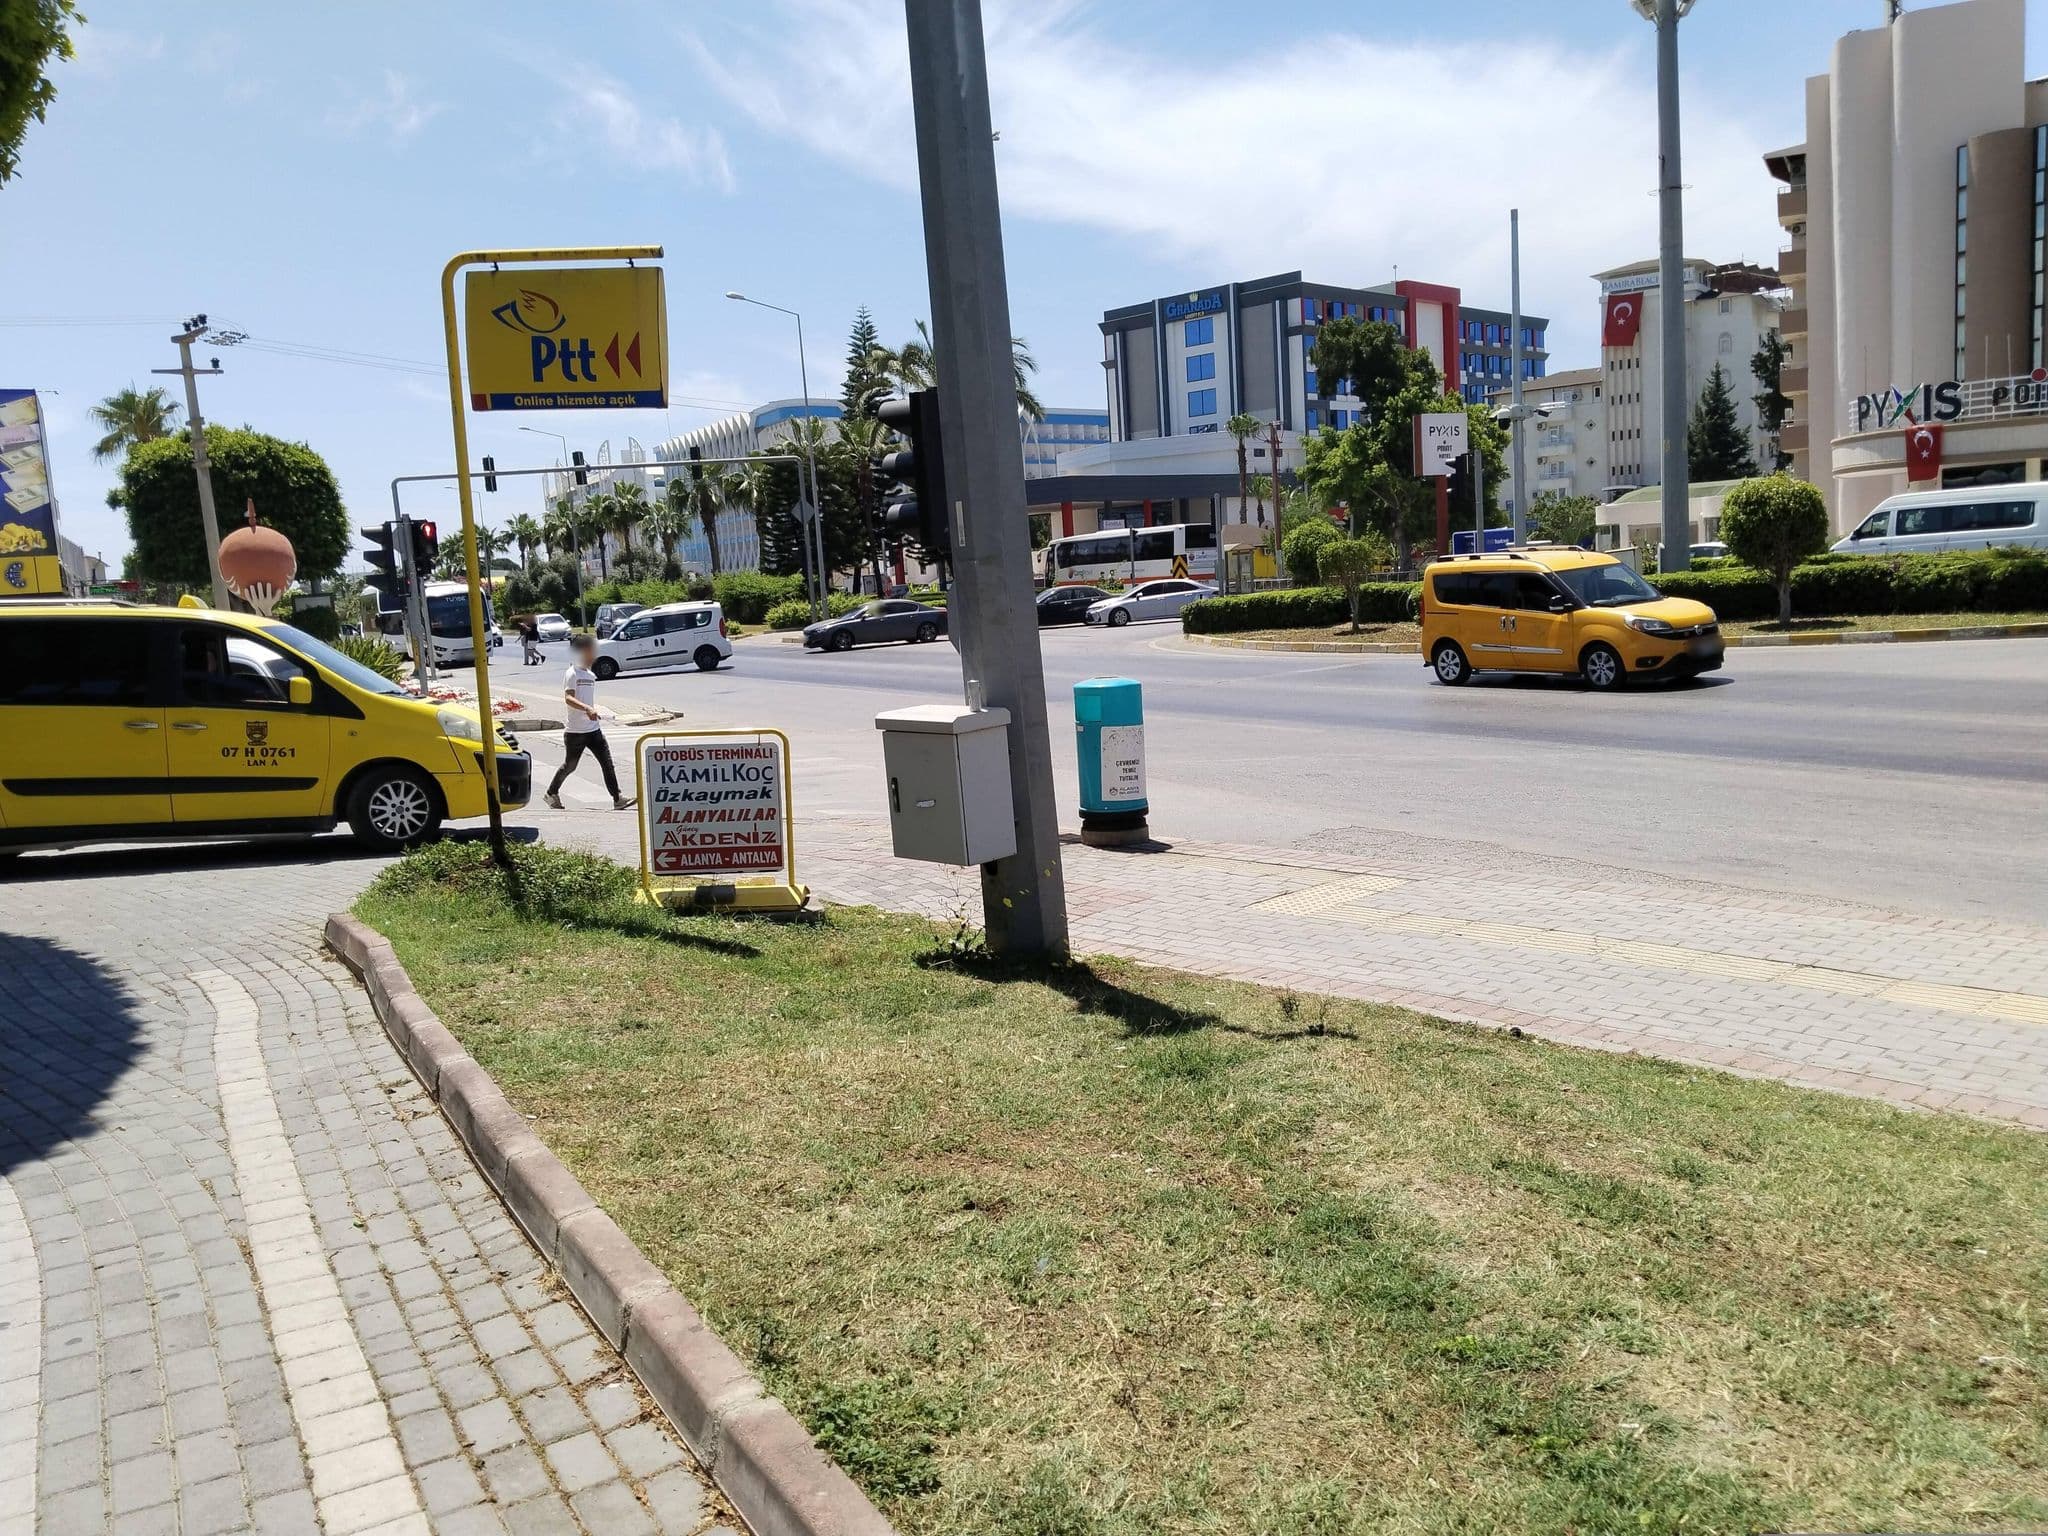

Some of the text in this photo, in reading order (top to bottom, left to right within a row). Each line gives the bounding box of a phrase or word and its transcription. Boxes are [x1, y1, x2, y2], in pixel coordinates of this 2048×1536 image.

[514, 394, 636, 408] Online hizmete açık
[1857, 381, 1962, 431] PYXIS
[1429, 425, 1460, 437] PYXIS
[221, 747, 296, 757] 07 H 0761
[654, 748, 704, 762] OTOBÜS
[655, 786, 773, 804] Özkaymak
[656, 806, 777, 824] ALANYALILAR
[662, 824, 777, 847] AKDENİZ
[681, 853, 723, 867] ALANYA
[732, 851, 778, 865] ANTALYA
